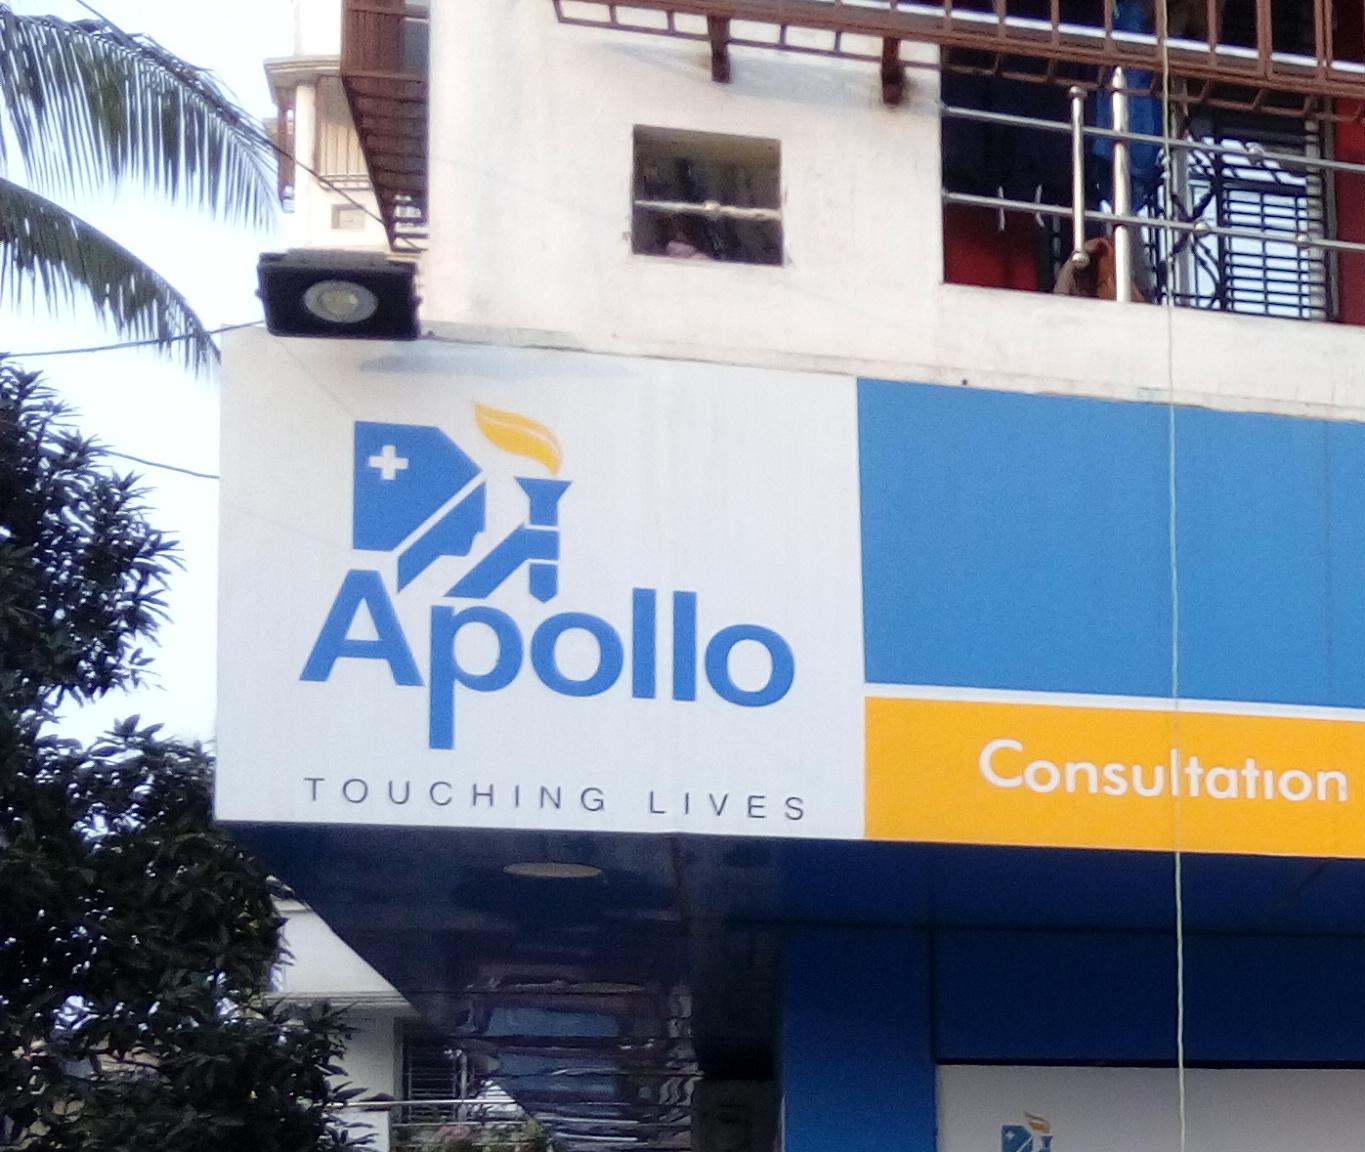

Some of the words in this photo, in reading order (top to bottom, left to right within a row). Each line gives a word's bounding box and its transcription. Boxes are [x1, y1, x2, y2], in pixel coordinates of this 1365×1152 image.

[298, 569, 795, 749] Apollo
[303, 776, 606, 812] TOUCHING
[648, 790, 805, 821] LIVES
[977, 738, 1349, 804] Consultation
